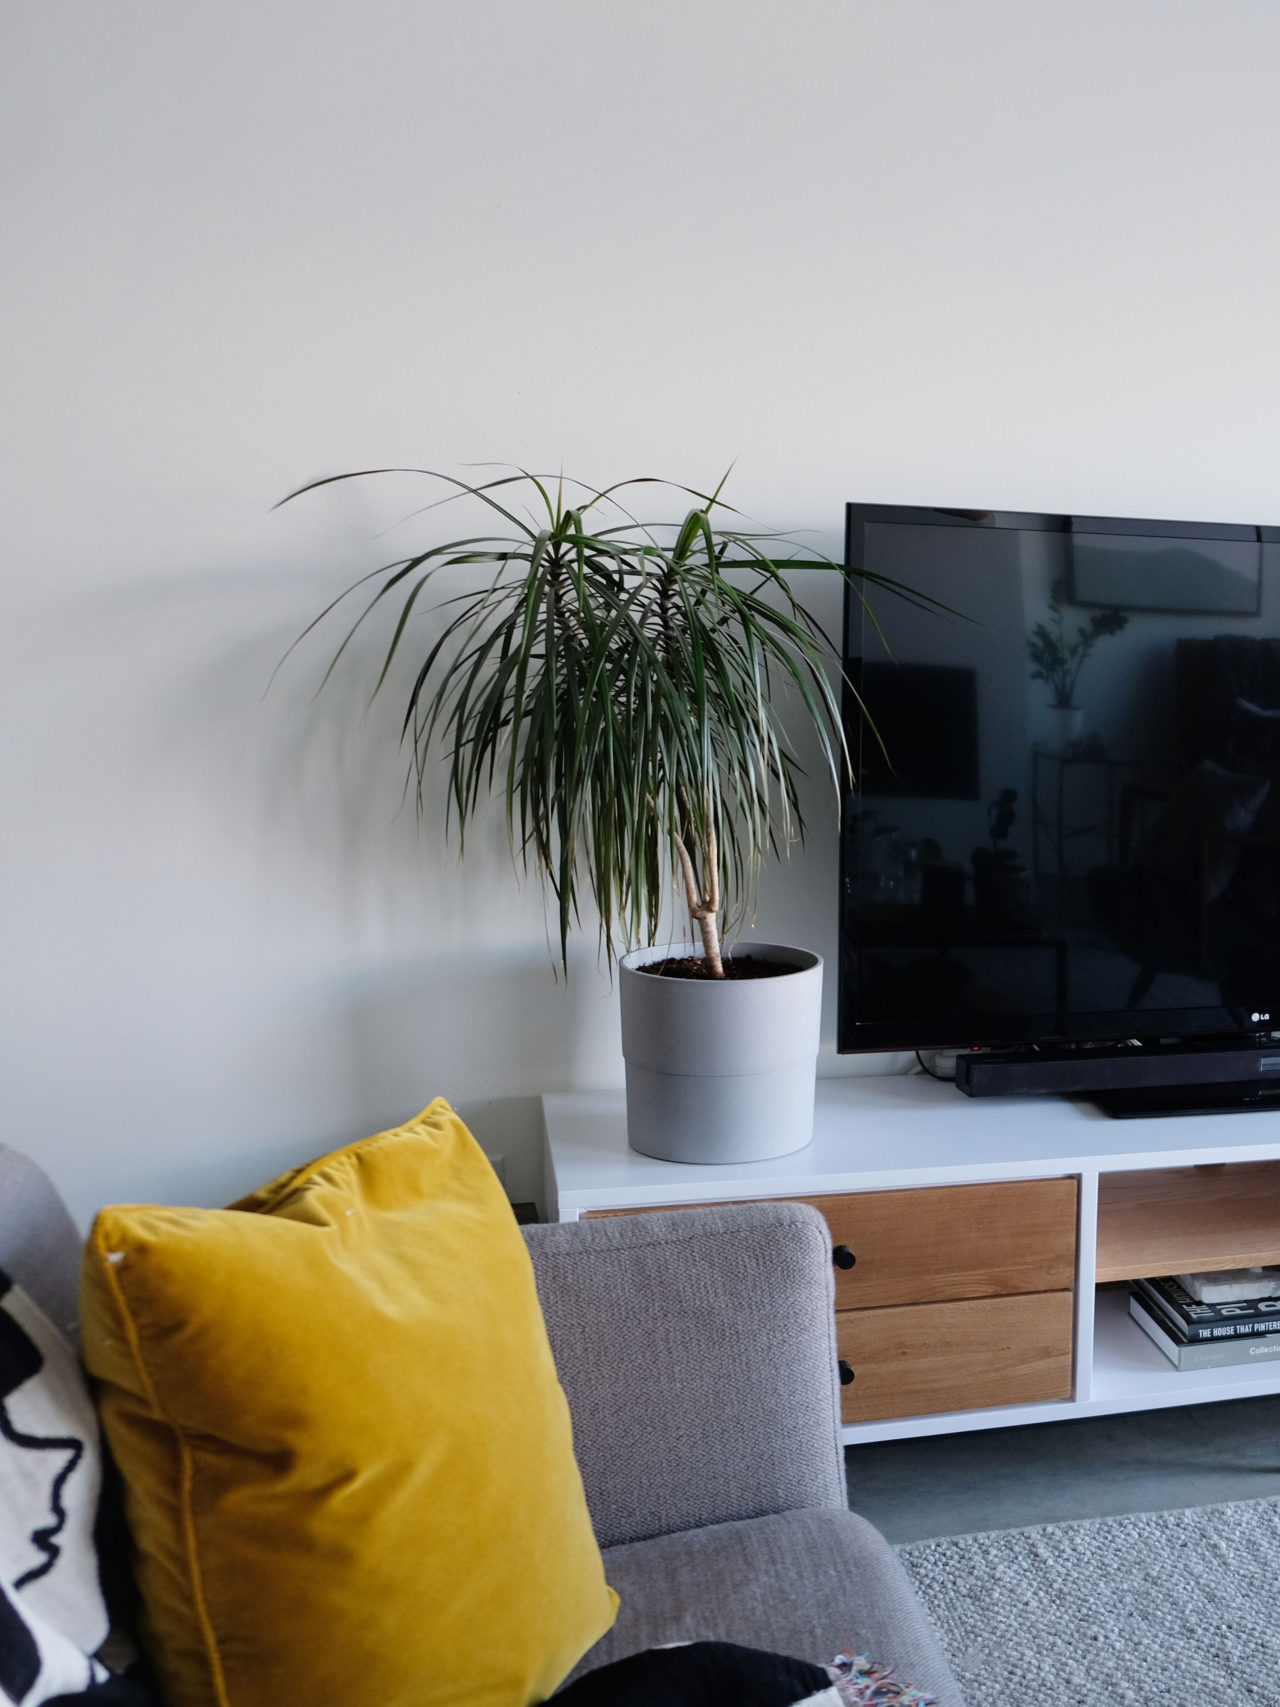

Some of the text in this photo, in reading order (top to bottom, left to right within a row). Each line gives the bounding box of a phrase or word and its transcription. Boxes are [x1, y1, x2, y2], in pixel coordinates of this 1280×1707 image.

[1198, 1329, 1212, 1338] THE
[1213, 1327, 1235, 1337] HOUSE
[1236, 1325, 1252, 1334] THAT
